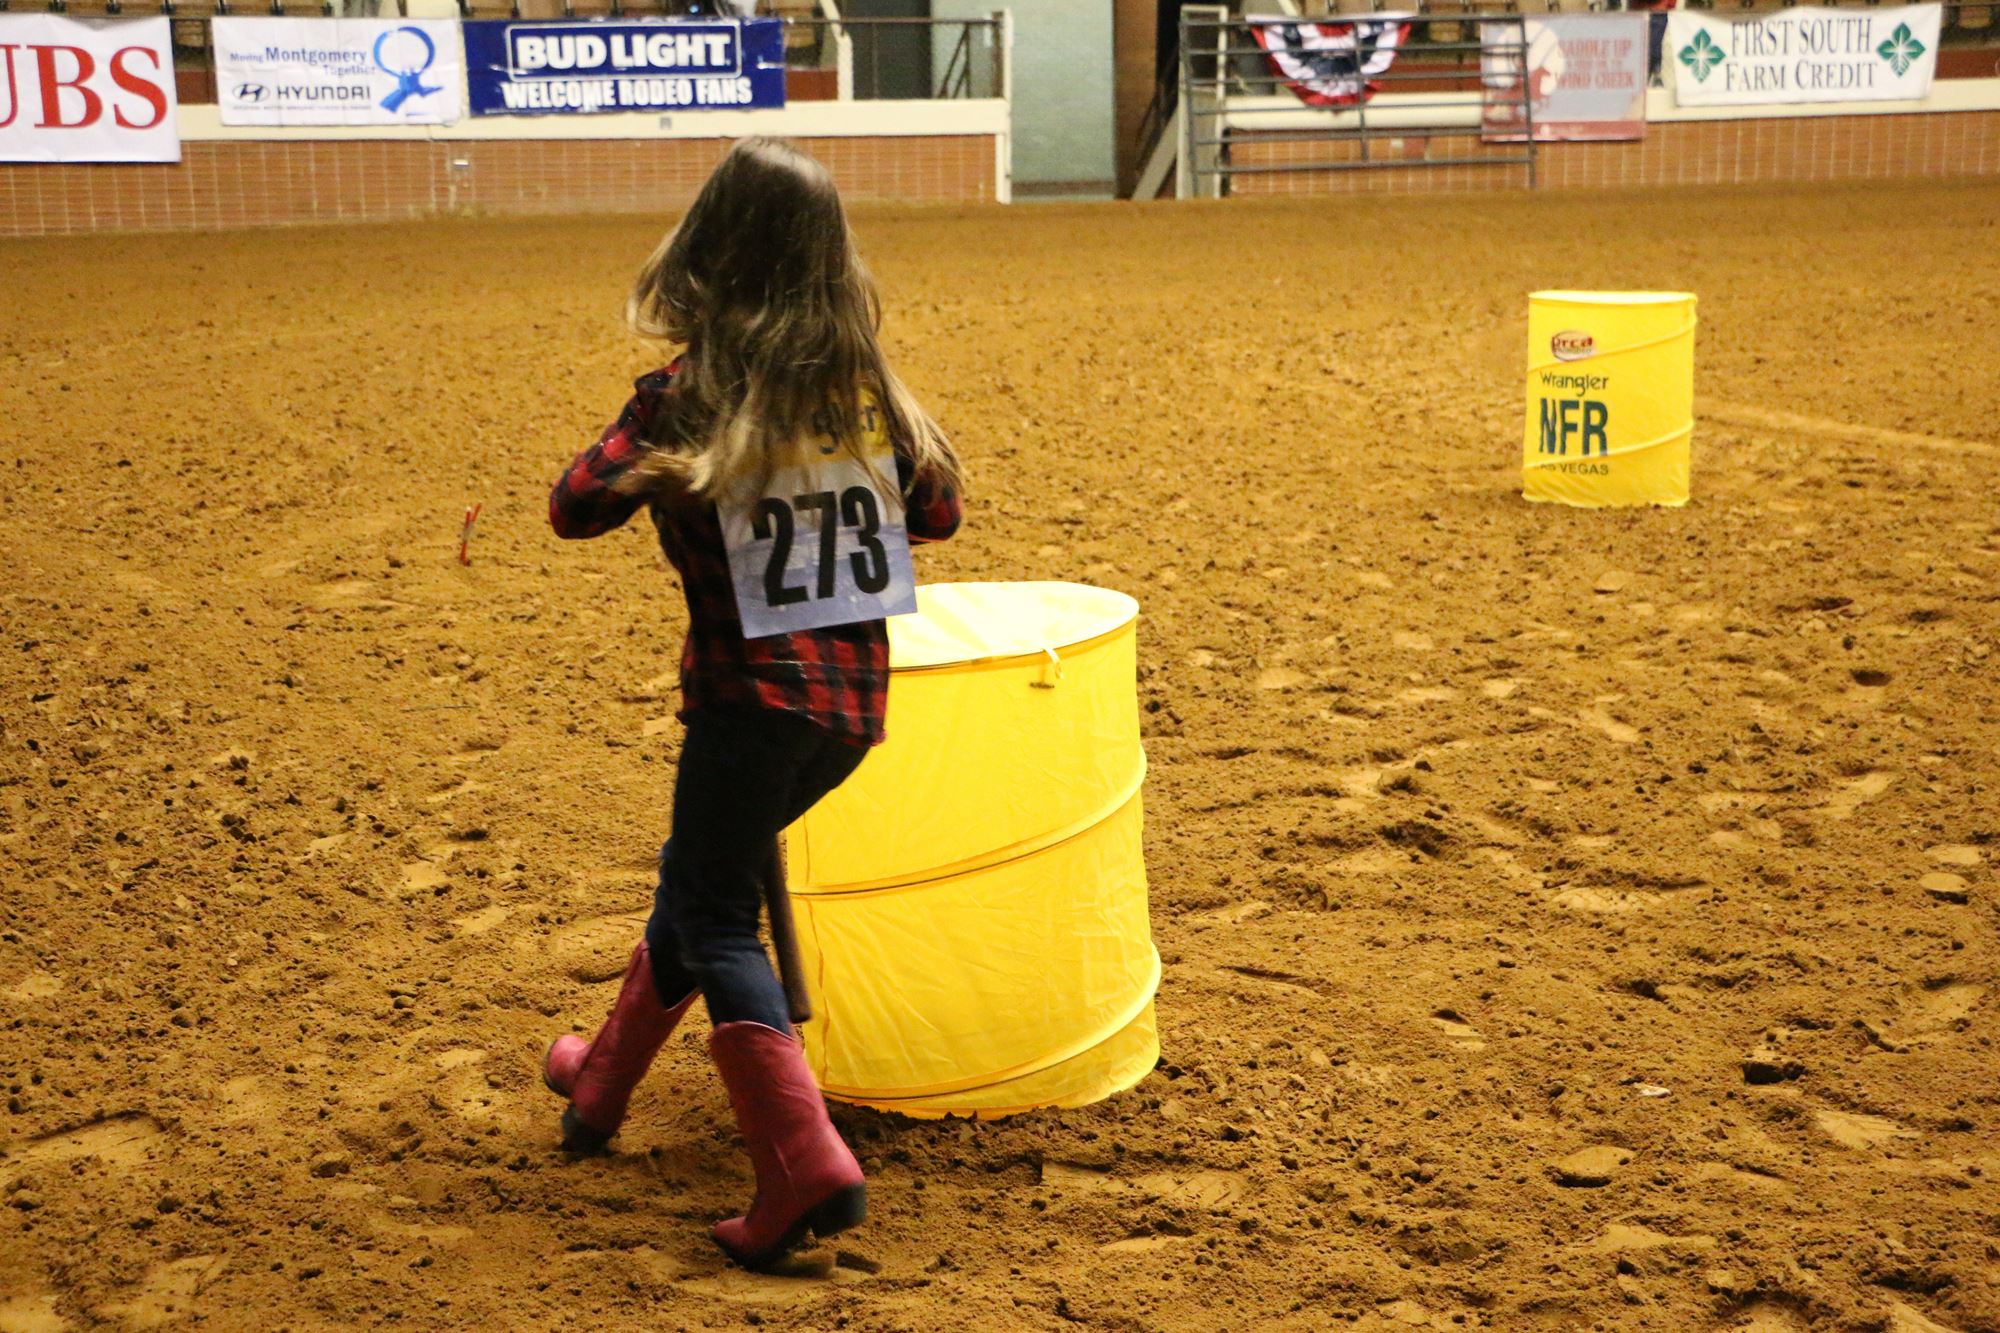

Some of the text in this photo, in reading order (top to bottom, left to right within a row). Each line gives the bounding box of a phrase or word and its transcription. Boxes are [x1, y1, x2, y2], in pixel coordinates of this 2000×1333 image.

[516, 33, 731, 69] BUD LIGHT
[1731, 18, 1871, 57] FIRST SOUTH
[265, 47, 367, 66] Montgomery
[1726, 58, 1877, 92] FARM CREDIT
[277, 85, 371, 100] HYUNDAI
[501, 76, 753, 109] WELCOME RODEO FANS
[1540, 372, 1609, 397] Wrangler
[1538, 398, 1608, 456] NFR
[1559, 463, 1609, 476] VEGAS
[752, 486, 890, 608] 273
